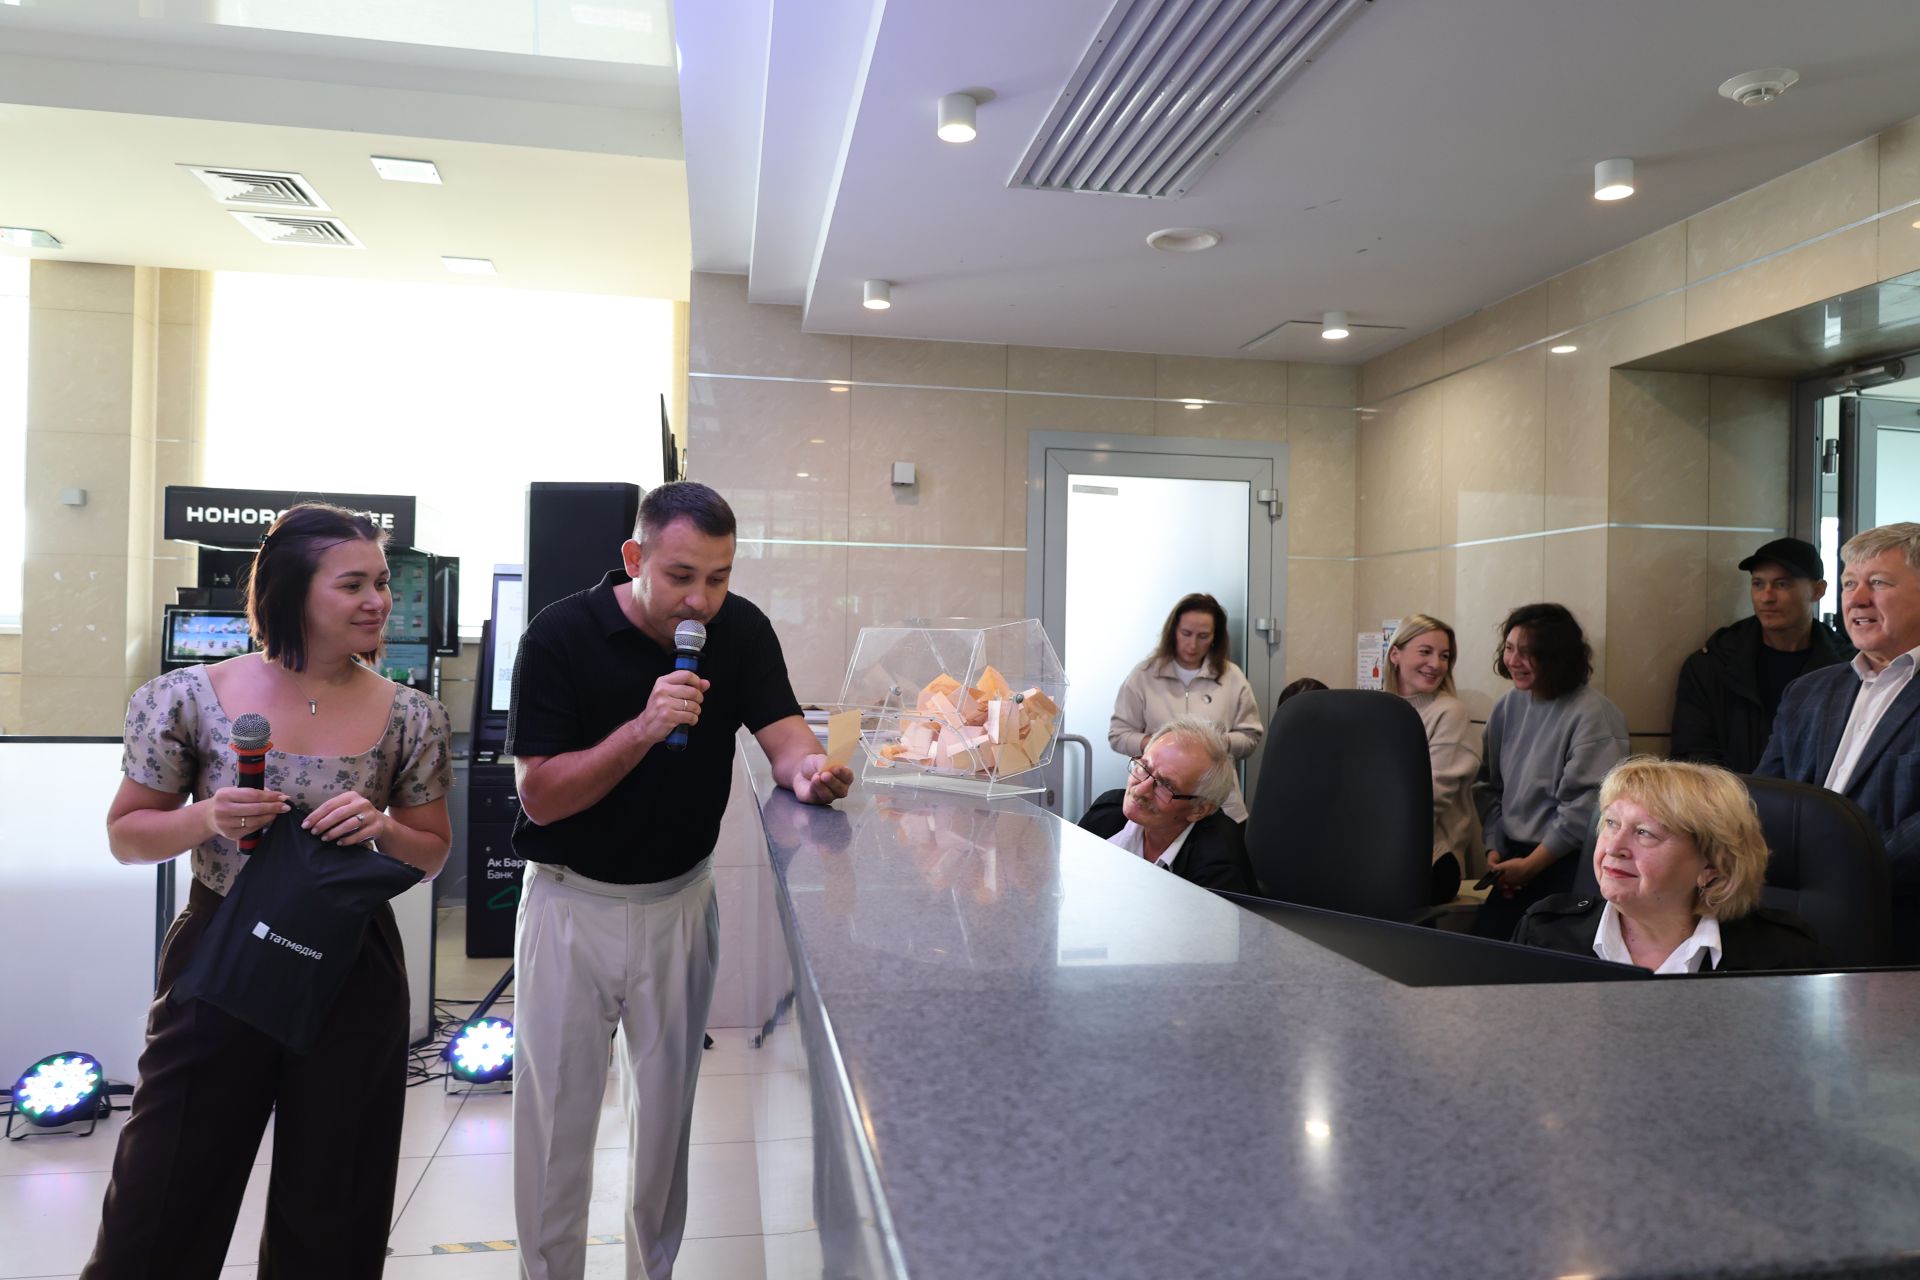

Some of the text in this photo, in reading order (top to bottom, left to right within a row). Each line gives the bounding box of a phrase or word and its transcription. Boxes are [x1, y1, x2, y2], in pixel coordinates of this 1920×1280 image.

[487, 858, 502, 868] Ак
[487, 869, 513, 879] Банк
[268, 932, 323, 960] татмедиа
